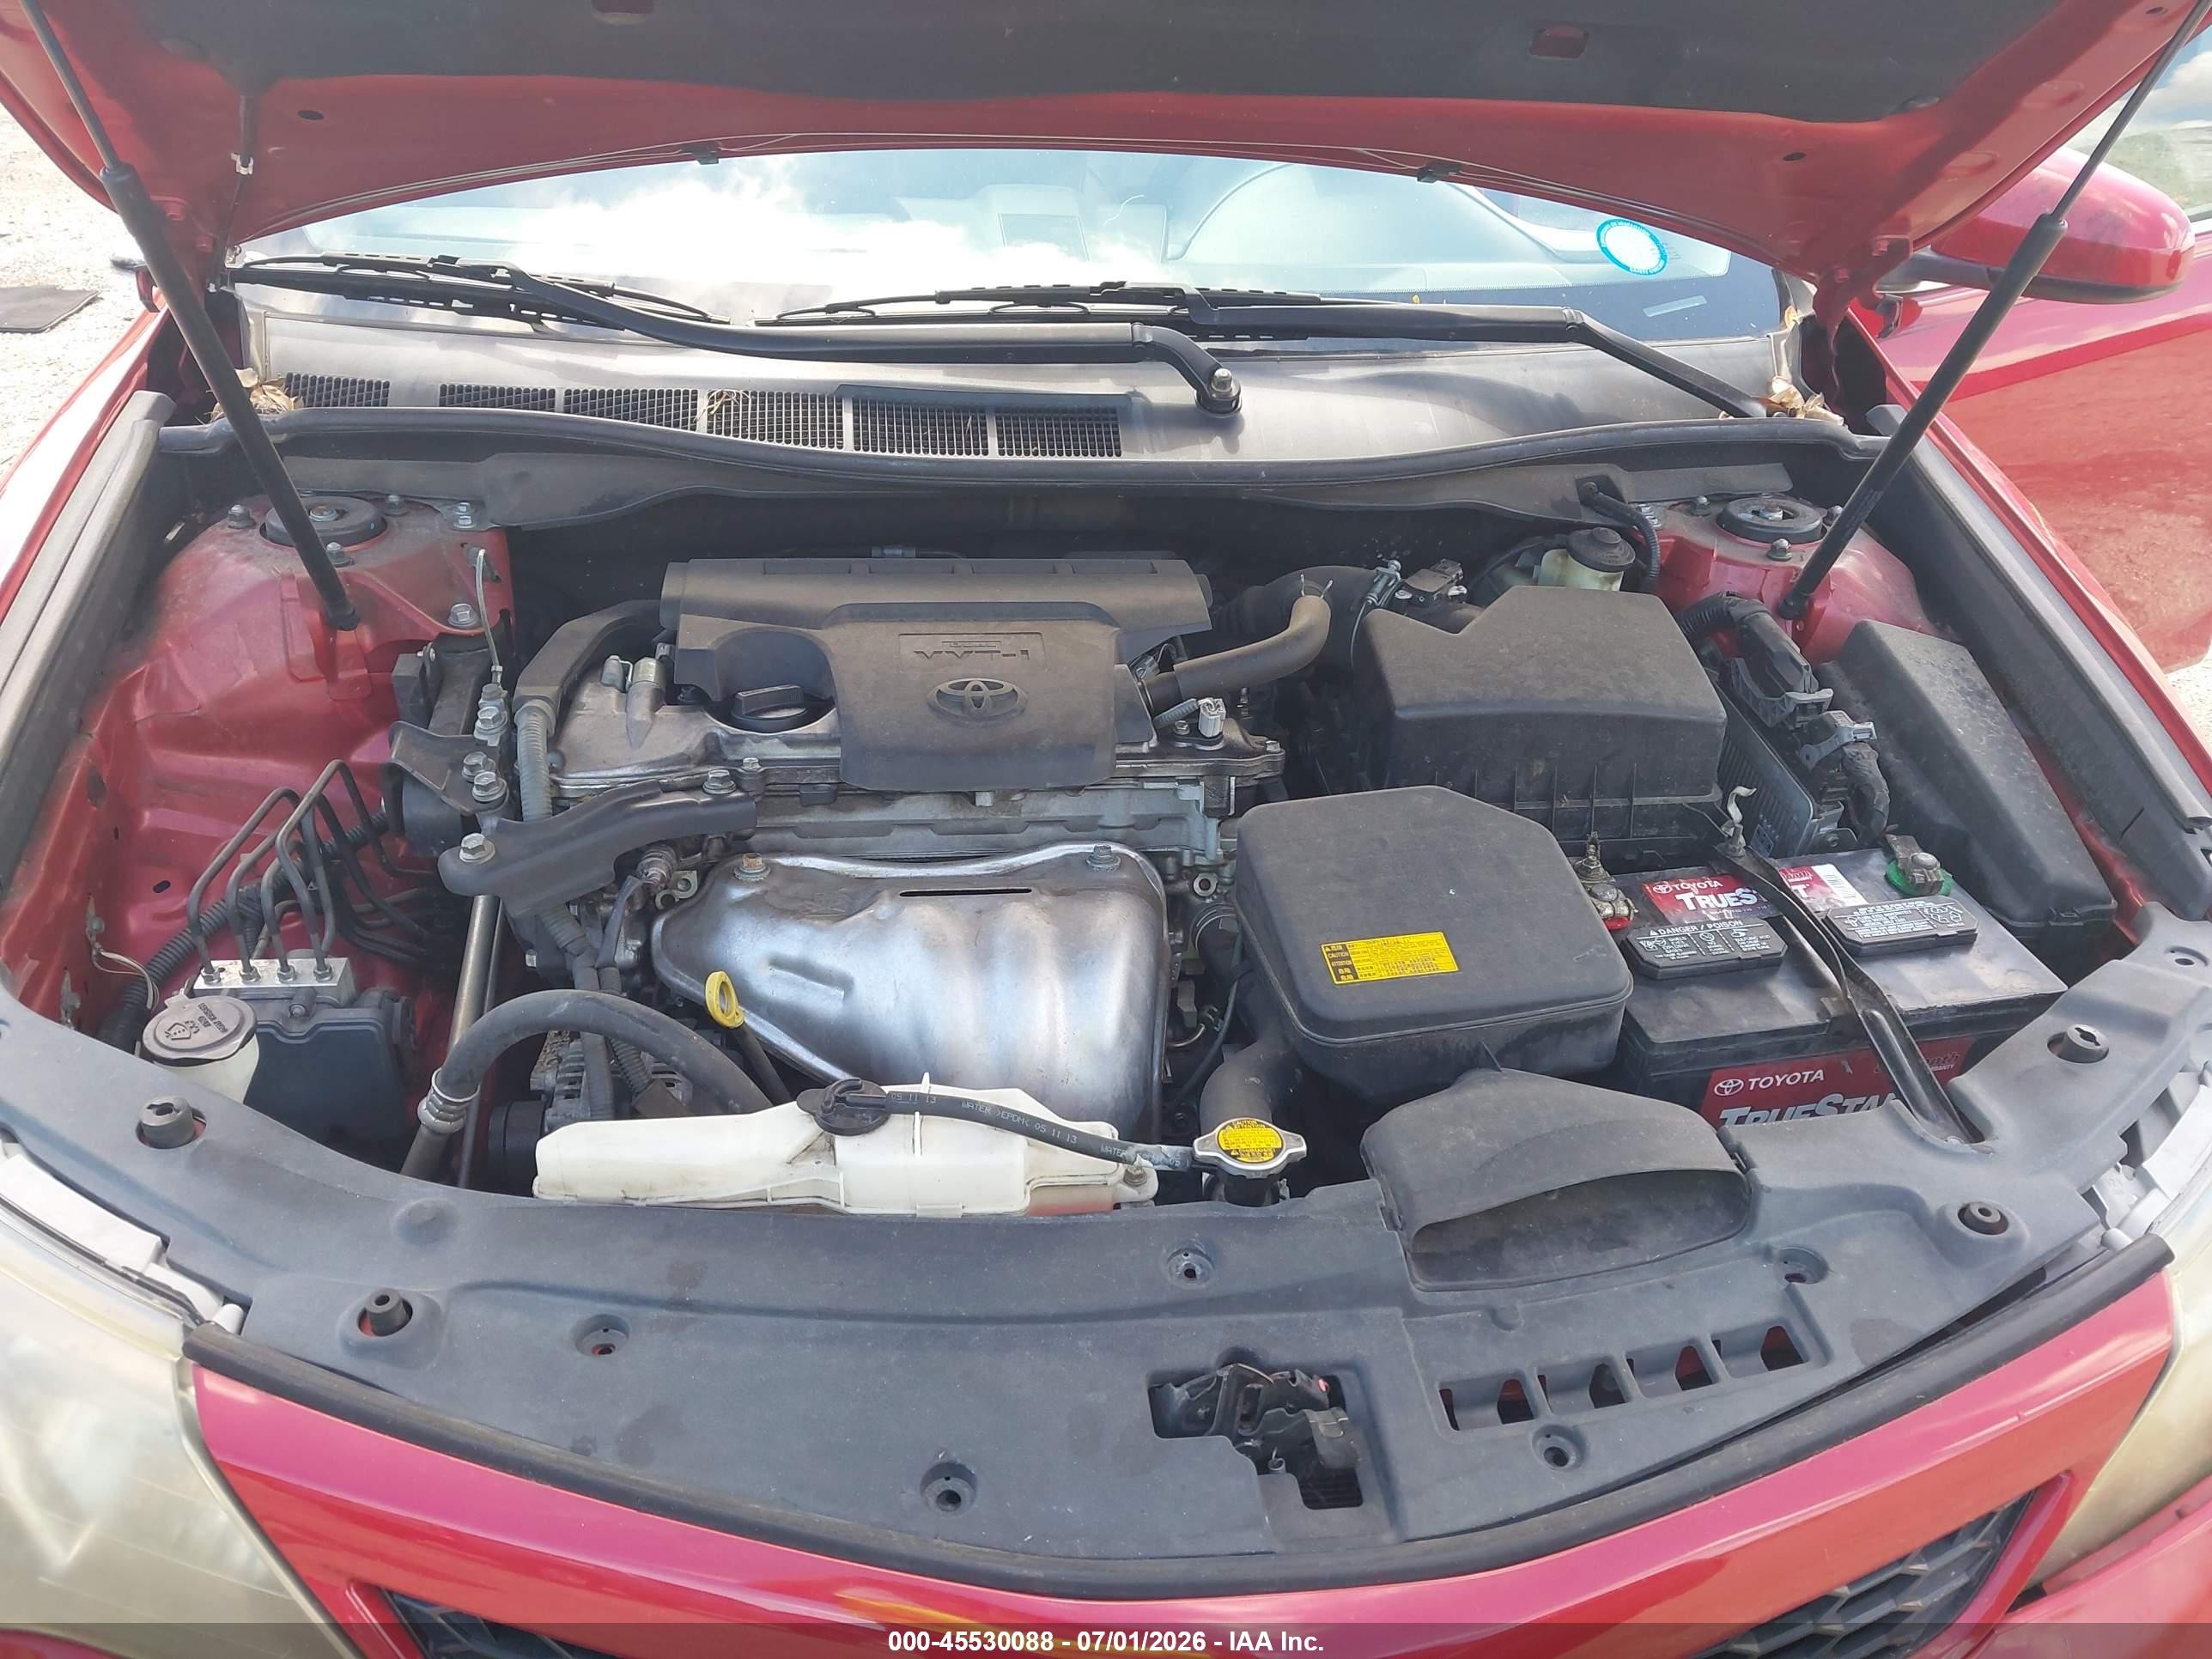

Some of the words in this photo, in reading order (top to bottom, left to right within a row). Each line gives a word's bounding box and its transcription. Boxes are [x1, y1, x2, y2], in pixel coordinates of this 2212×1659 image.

[1673, 879, 1723, 892] TOYOTA
[1658, 925, 1698, 935] DANGER
[1707, 921, 1744, 930] POISON
[1748, 1070, 1824, 1091] TOYOTA
[926, 1095, 937, 1105] 13
[1719, 1093, 1897, 1126] TRUESTA
[961, 1101, 992, 1115] WATER
[1034, 1121, 1048, 1134] 05
[1051, 1127, 1061, 1139] 11
[1066, 1133, 1078, 1145] 13
